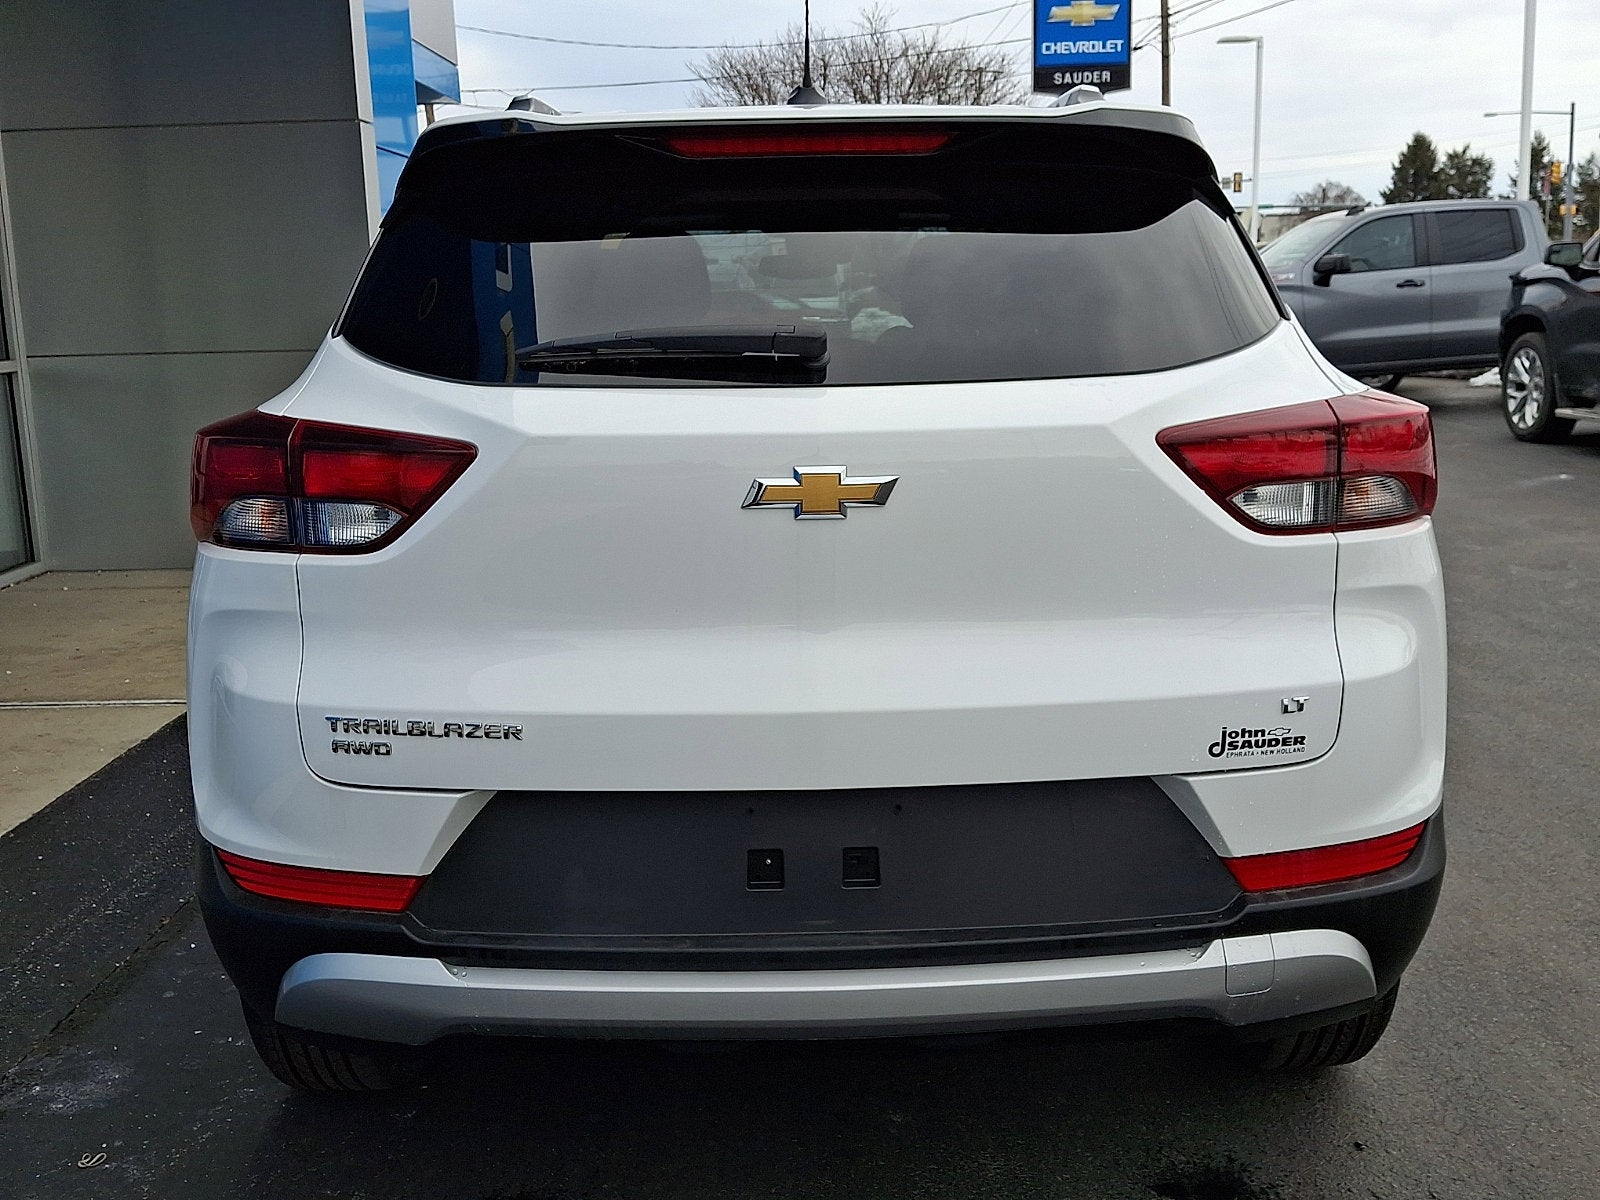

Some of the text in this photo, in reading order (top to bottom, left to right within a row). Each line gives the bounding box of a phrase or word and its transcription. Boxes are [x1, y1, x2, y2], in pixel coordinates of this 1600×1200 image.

[1042, 40, 1124, 55] CHEVROLET
[1053, 71, 1111, 85] SAUDER
[1281, 696, 1310, 714] LT
[324, 716, 524, 740] TRAILBLAZER
[331, 739, 392, 756] AWD
[1227, 735, 1307, 751] SAUDER
[1226, 751, 1255, 759] EPHRATA
[1276, 746, 1306, 754] HOLLAND
